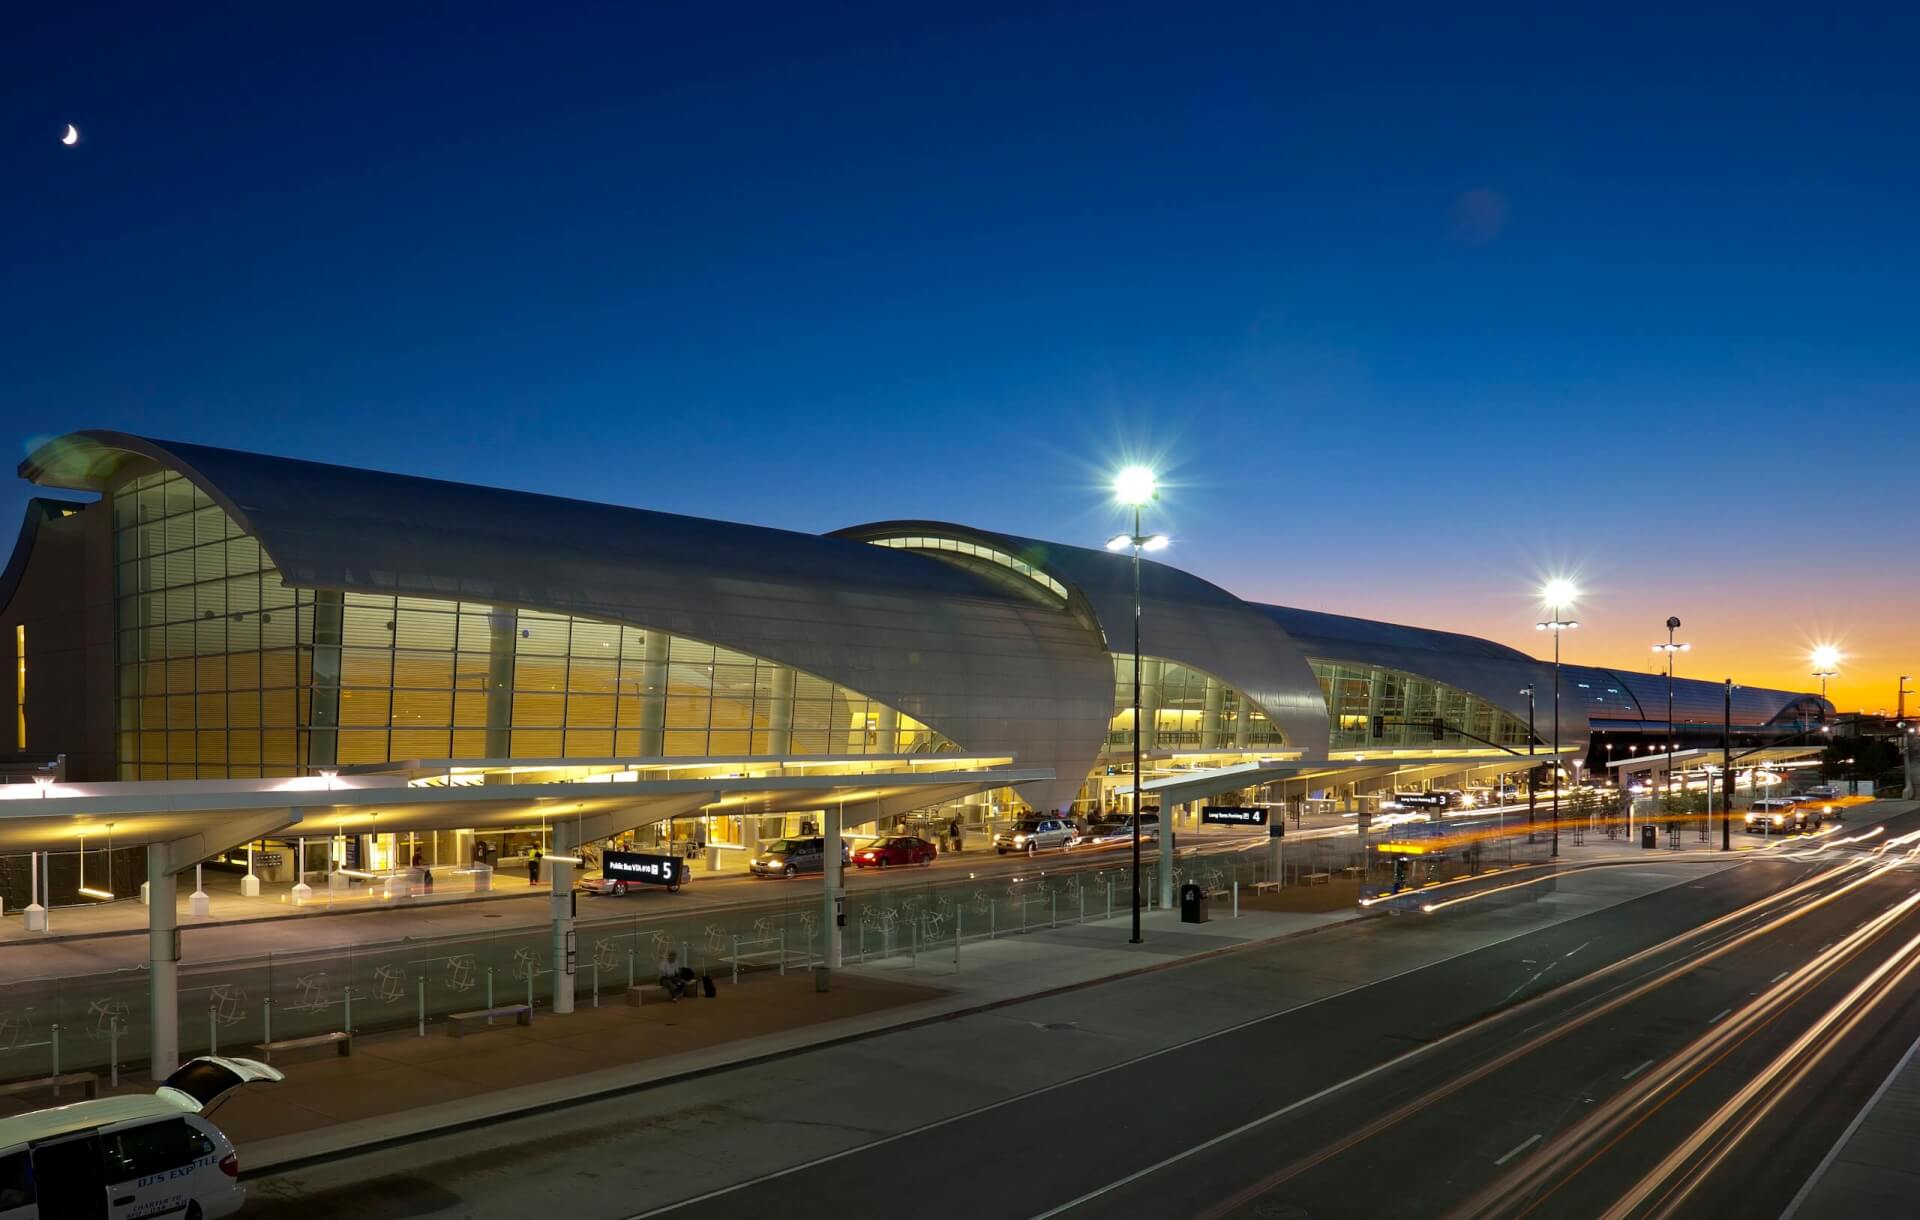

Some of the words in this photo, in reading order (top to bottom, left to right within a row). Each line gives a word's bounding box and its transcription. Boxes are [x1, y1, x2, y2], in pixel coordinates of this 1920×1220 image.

[1439, 795, 1446, 805] 3
[1252, 810, 1260, 822] 4
[610, 861, 623, 870] Public
[623, 863, 632, 871] Bus
[663, 861, 671, 879] 5
[138, 1174, 165, 1188] DJ'S
